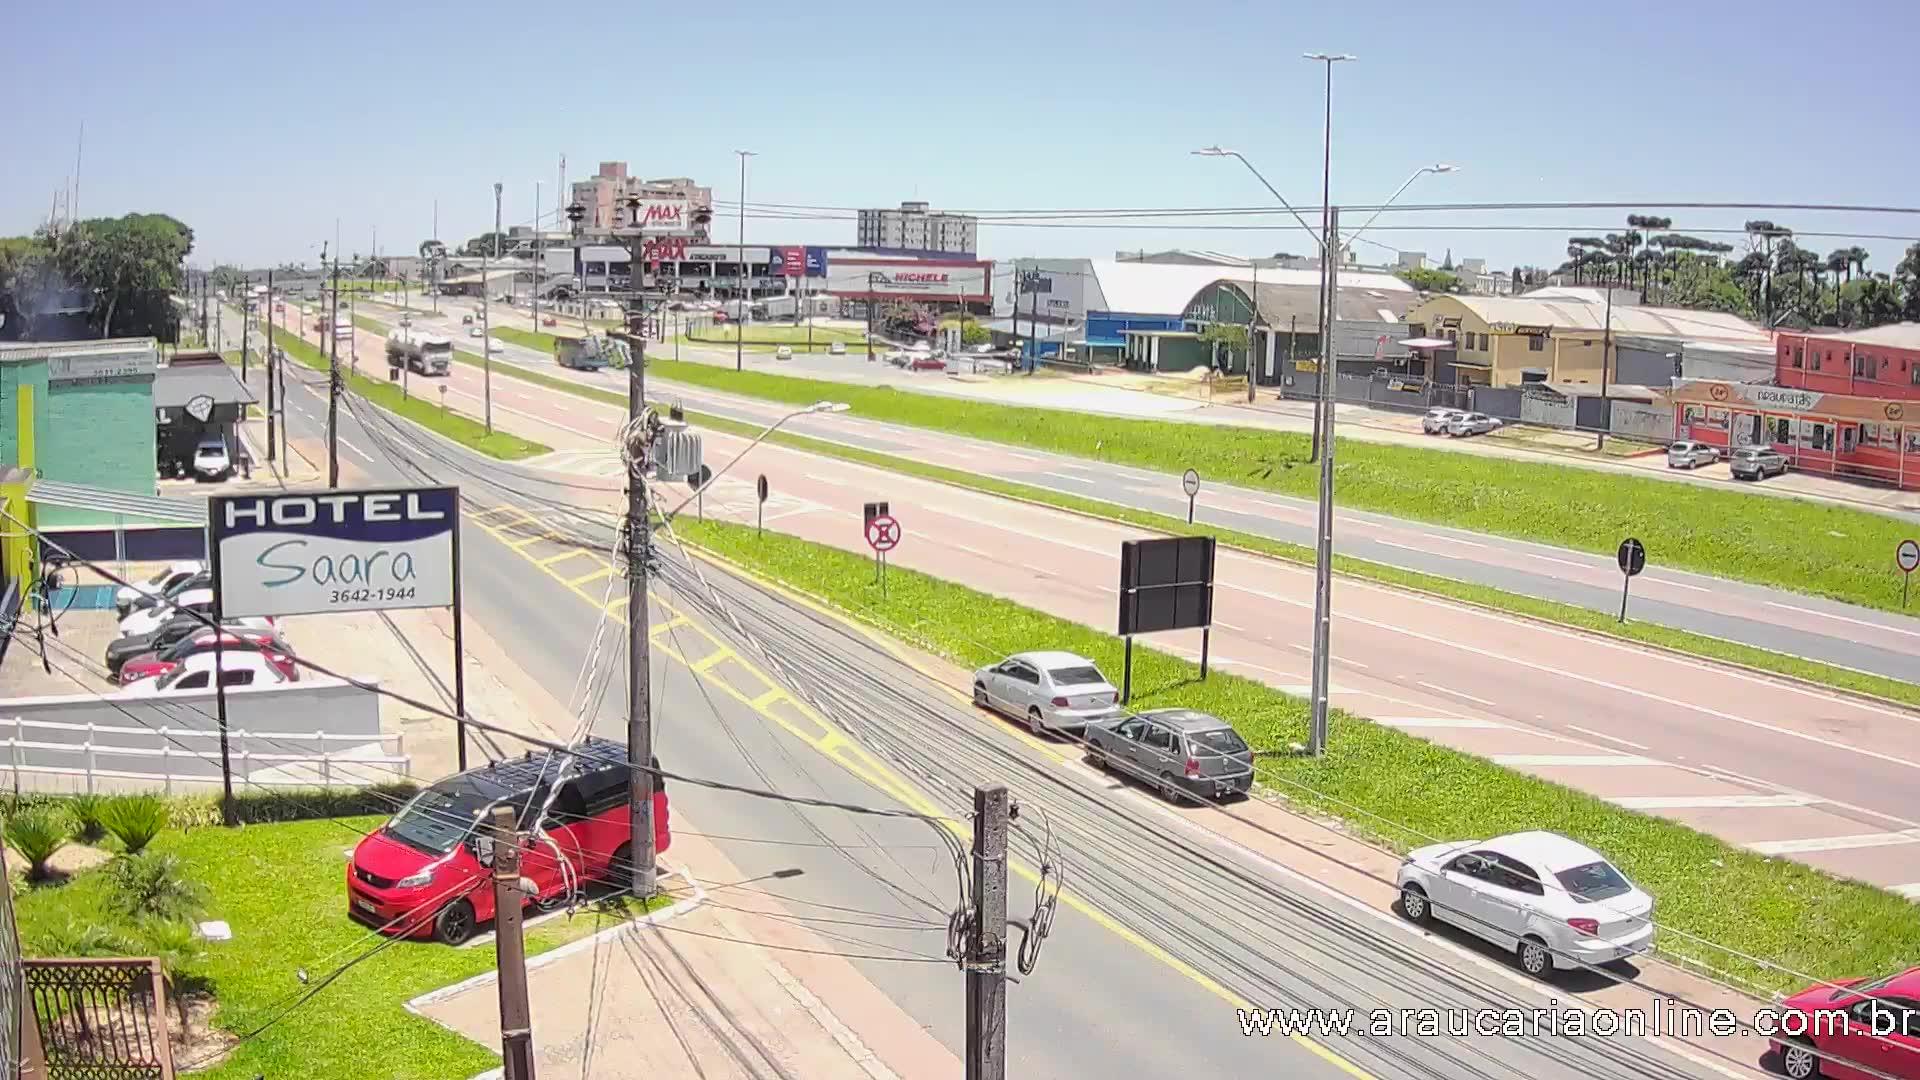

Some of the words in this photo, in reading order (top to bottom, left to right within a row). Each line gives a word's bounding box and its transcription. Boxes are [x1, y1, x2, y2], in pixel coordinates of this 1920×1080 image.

[643, 206, 680, 224] MAX
[225, 493, 445, 528] HOTEL
[256, 540, 417, 587] Saara
[330, 586, 416, 603] 3642-1944
